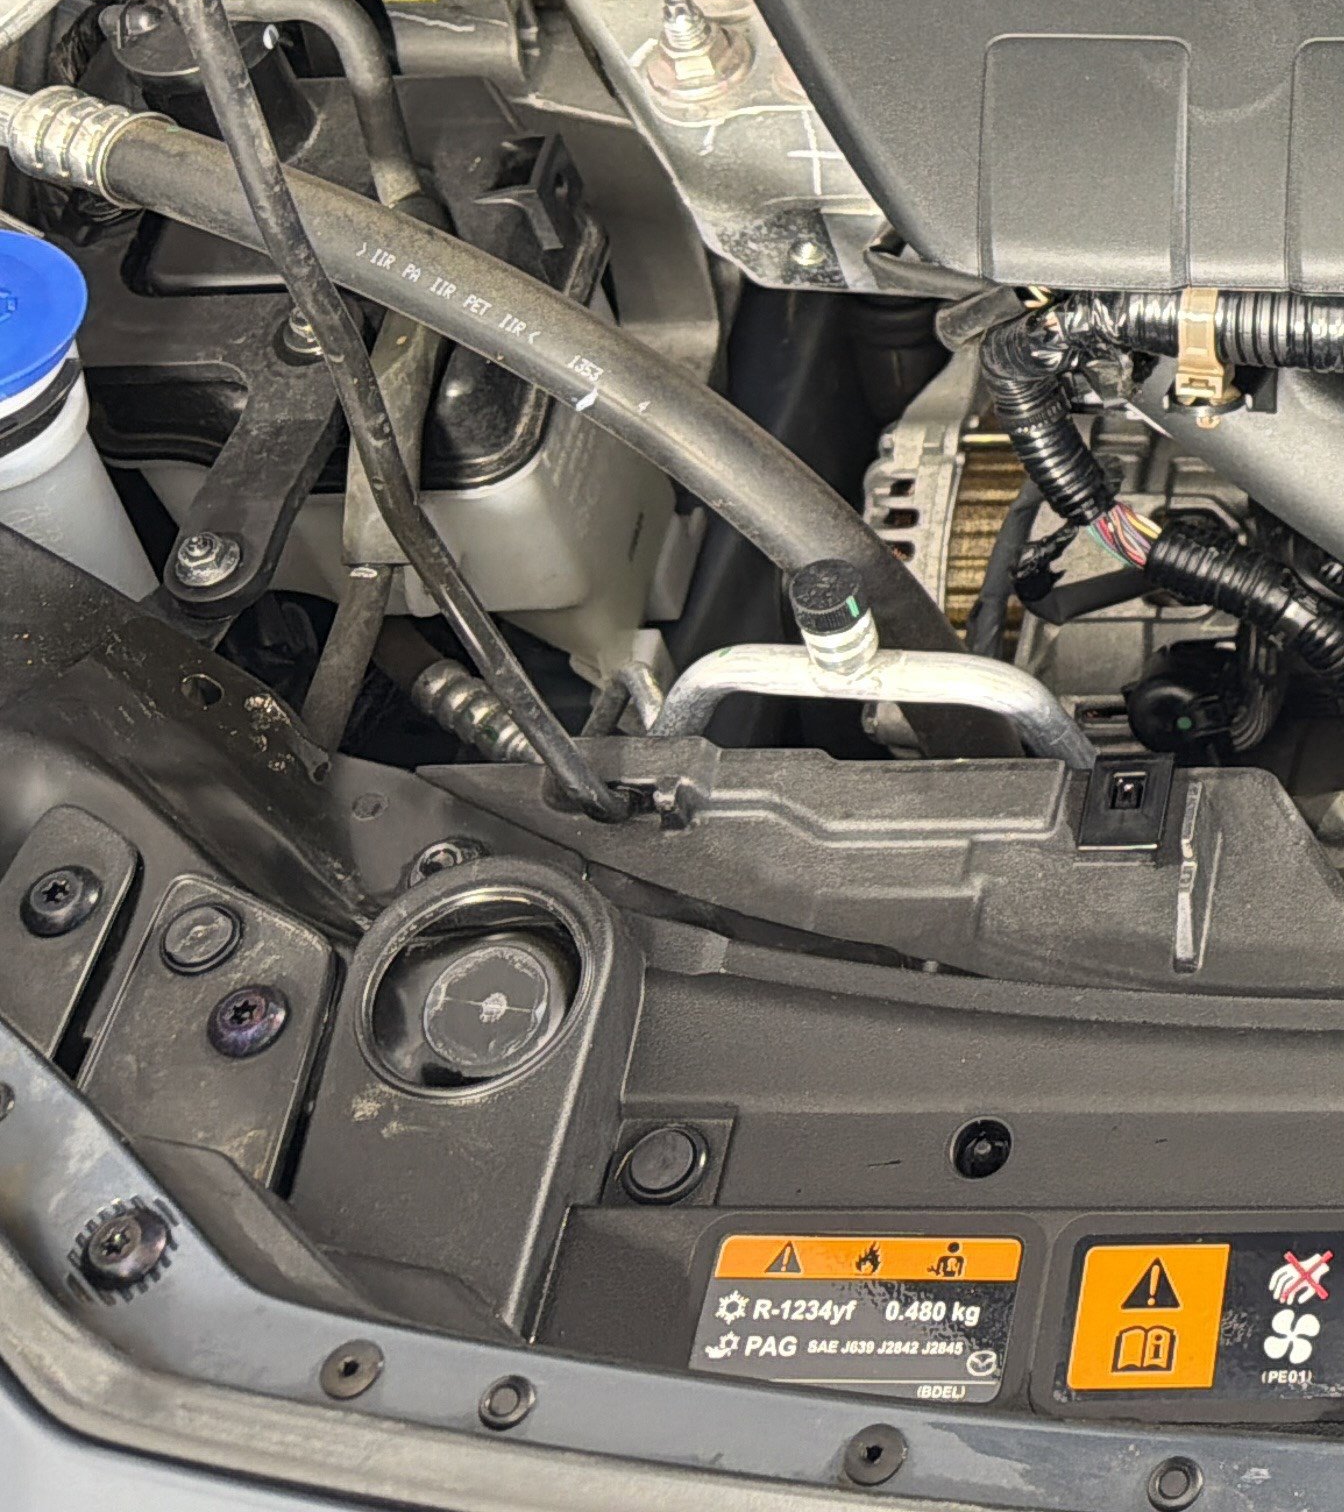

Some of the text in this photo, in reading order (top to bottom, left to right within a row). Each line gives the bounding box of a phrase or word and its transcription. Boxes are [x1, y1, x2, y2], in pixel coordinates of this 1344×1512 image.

[402, 263, 422, 283] PA
[430, 277, 458, 301] IIR
[463, 294, 493, 317] PET
[567, 354, 605, 383] 1353
[752, 1299, 981, 1327] R-1234yf 0.480 kg
[744, 1335, 964, 1358] PAG SAE J639 J2842 J2845
